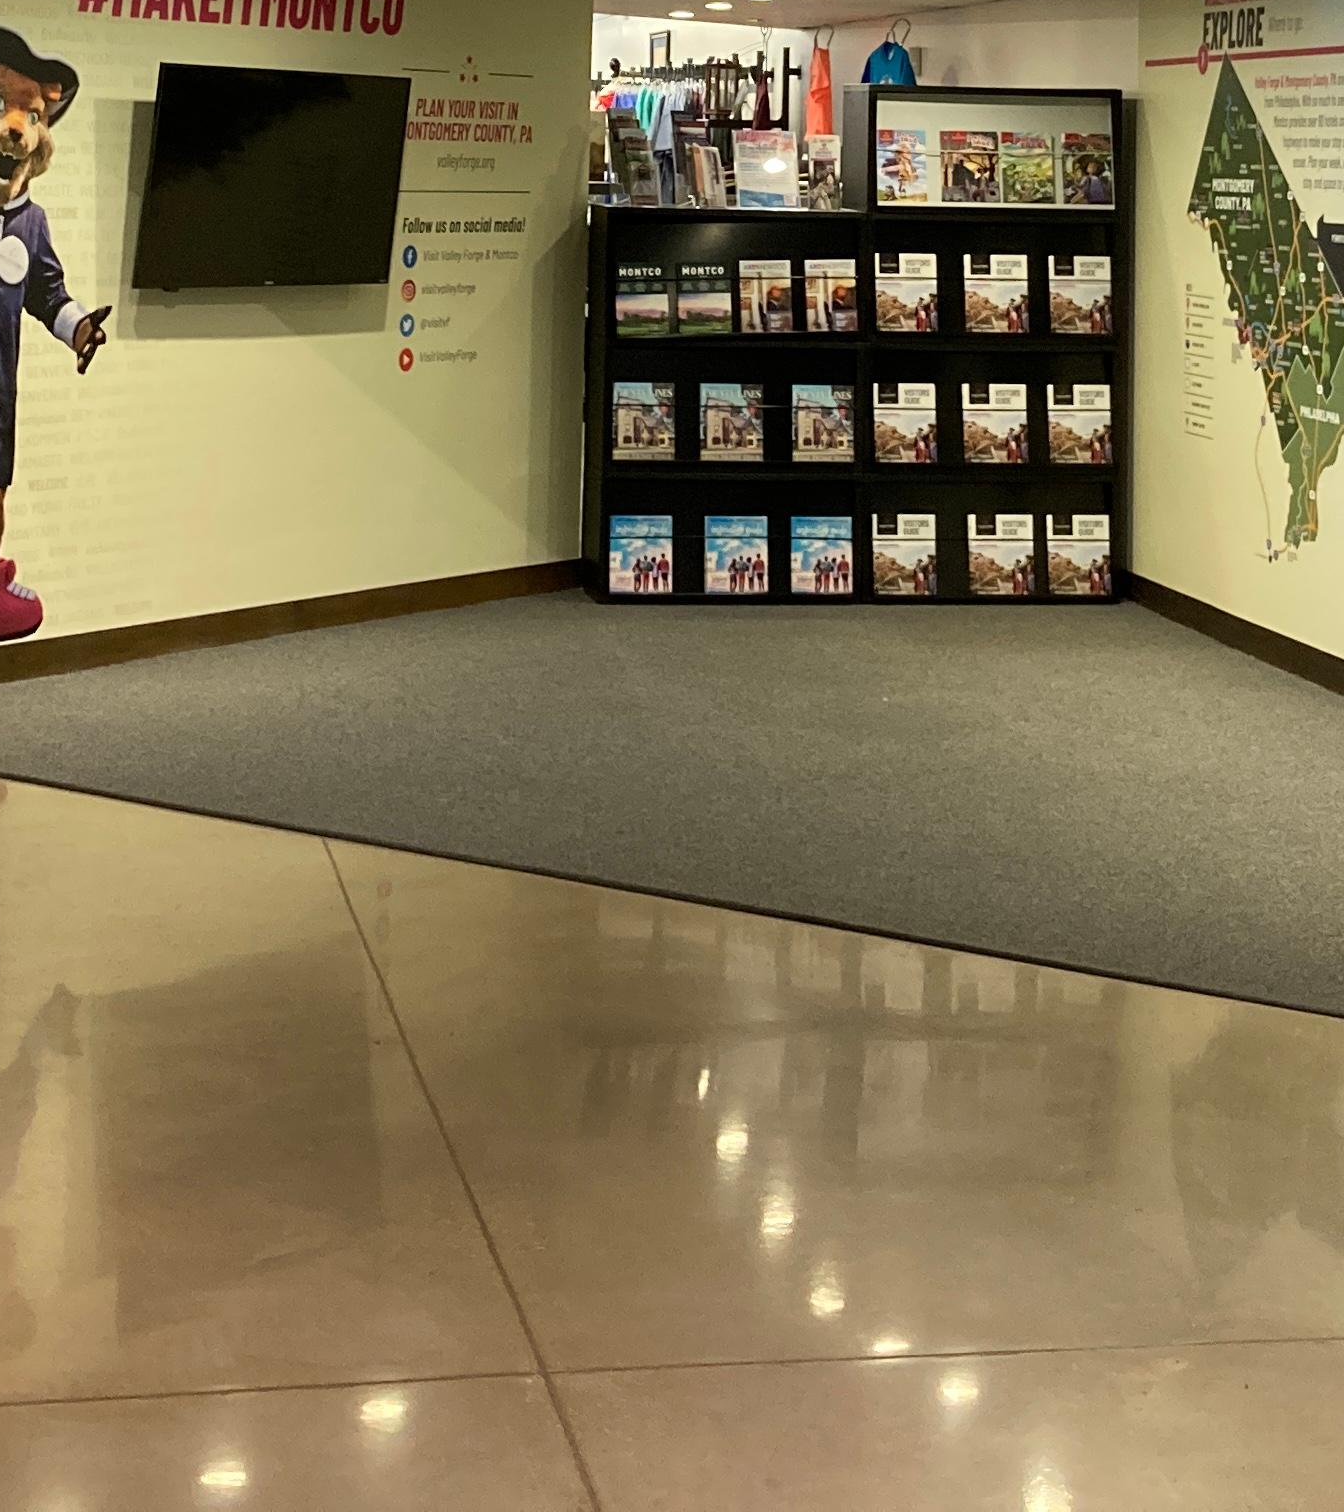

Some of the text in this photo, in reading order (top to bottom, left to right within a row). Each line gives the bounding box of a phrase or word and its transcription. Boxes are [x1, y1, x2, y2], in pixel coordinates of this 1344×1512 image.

[1203, 7, 1265, 51] EXPLORE
[416, 99, 519, 120] PLAN YOUR VISIT IN
[406, 122, 532, 144] ONTGOMERY COUNTY, PA
[437, 154, 495, 171] valleyforge.org
[403, 217, 526, 233] Follow us on social media!
[424, 250, 439, 261] Visit
[441, 250, 461, 263] Valley
[464, 249, 483, 262] Forge
[485, 250, 490, 260] &
[619, 267, 661, 276] MONTCO
[682, 266, 724, 276] MONTCO
